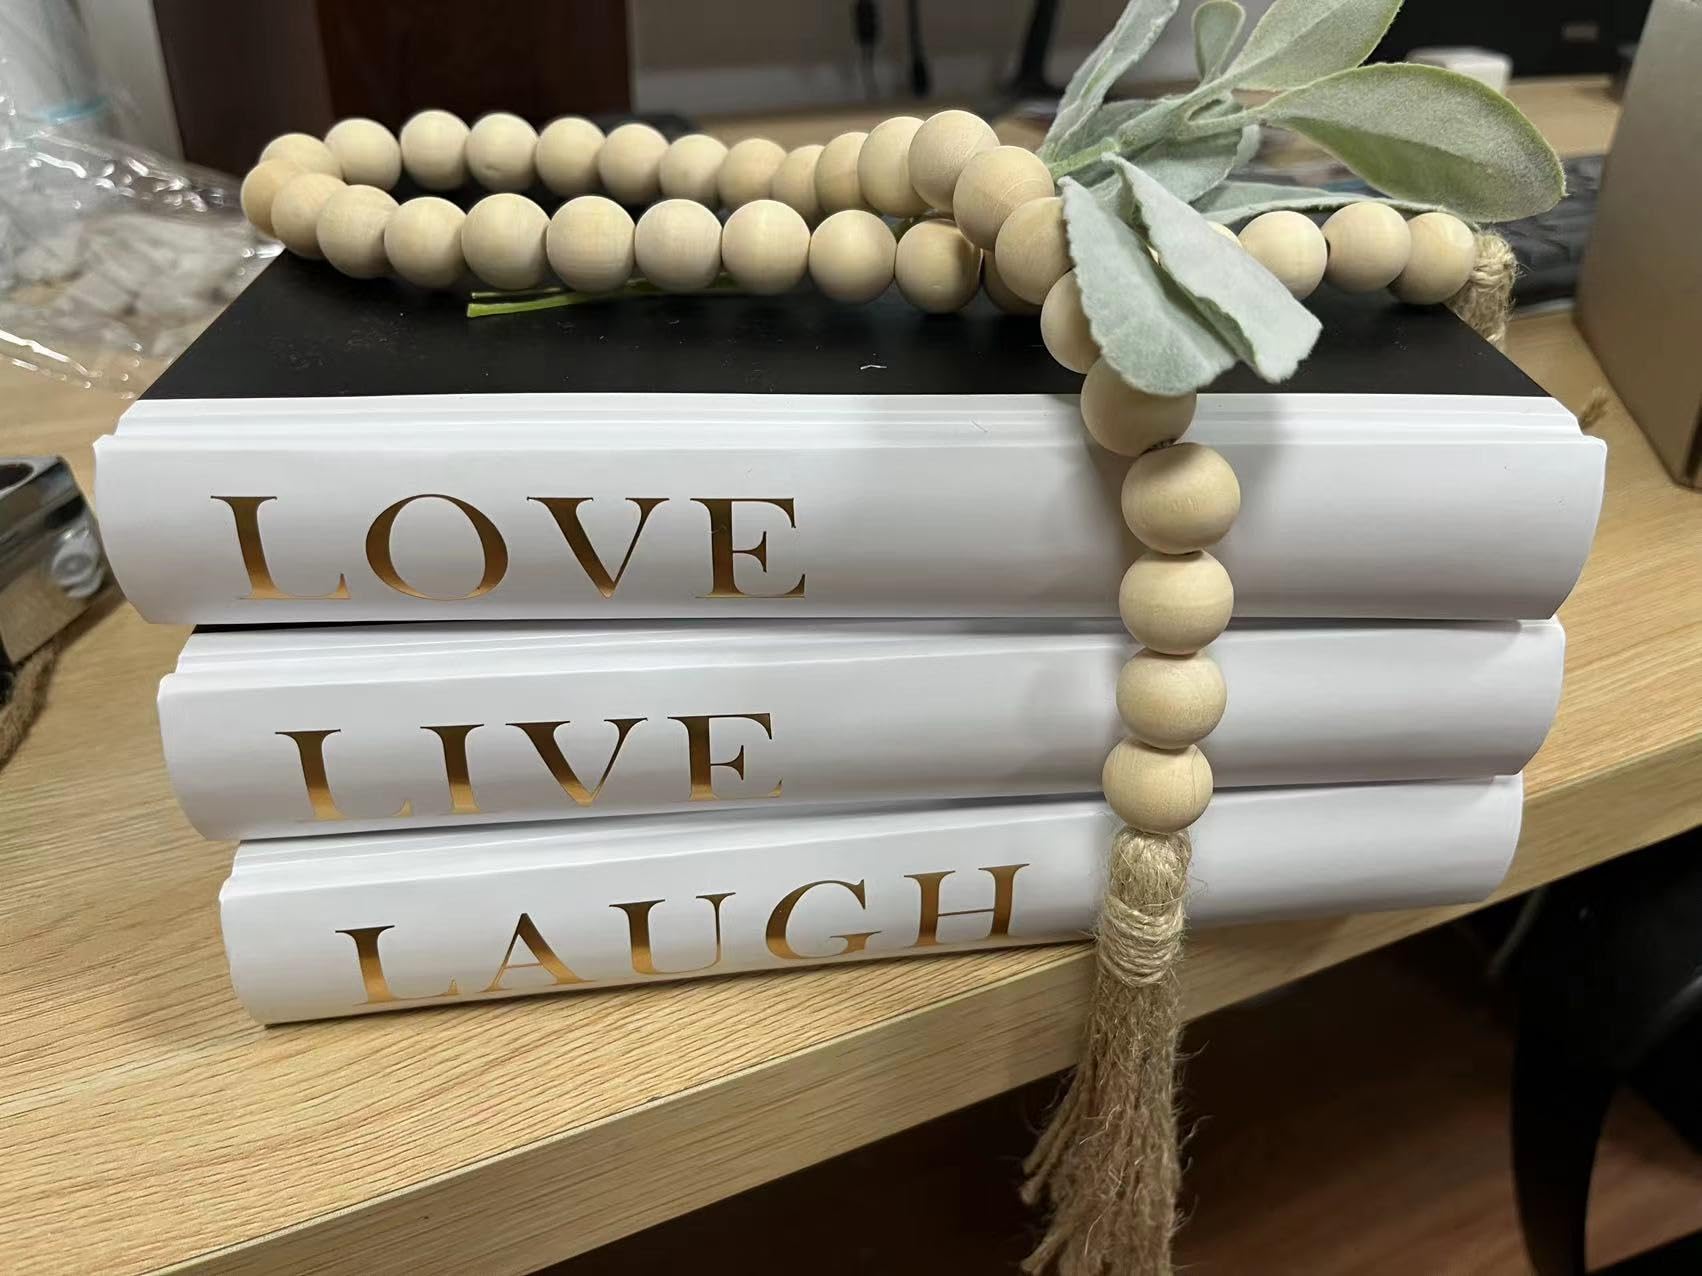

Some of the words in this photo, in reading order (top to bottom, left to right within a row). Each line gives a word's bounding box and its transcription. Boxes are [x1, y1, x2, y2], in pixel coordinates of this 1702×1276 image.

[211, 494, 806, 600] LOVE
[275, 712, 783, 821] LIVE
[335, 863, 1030, 1005] LAUGH
